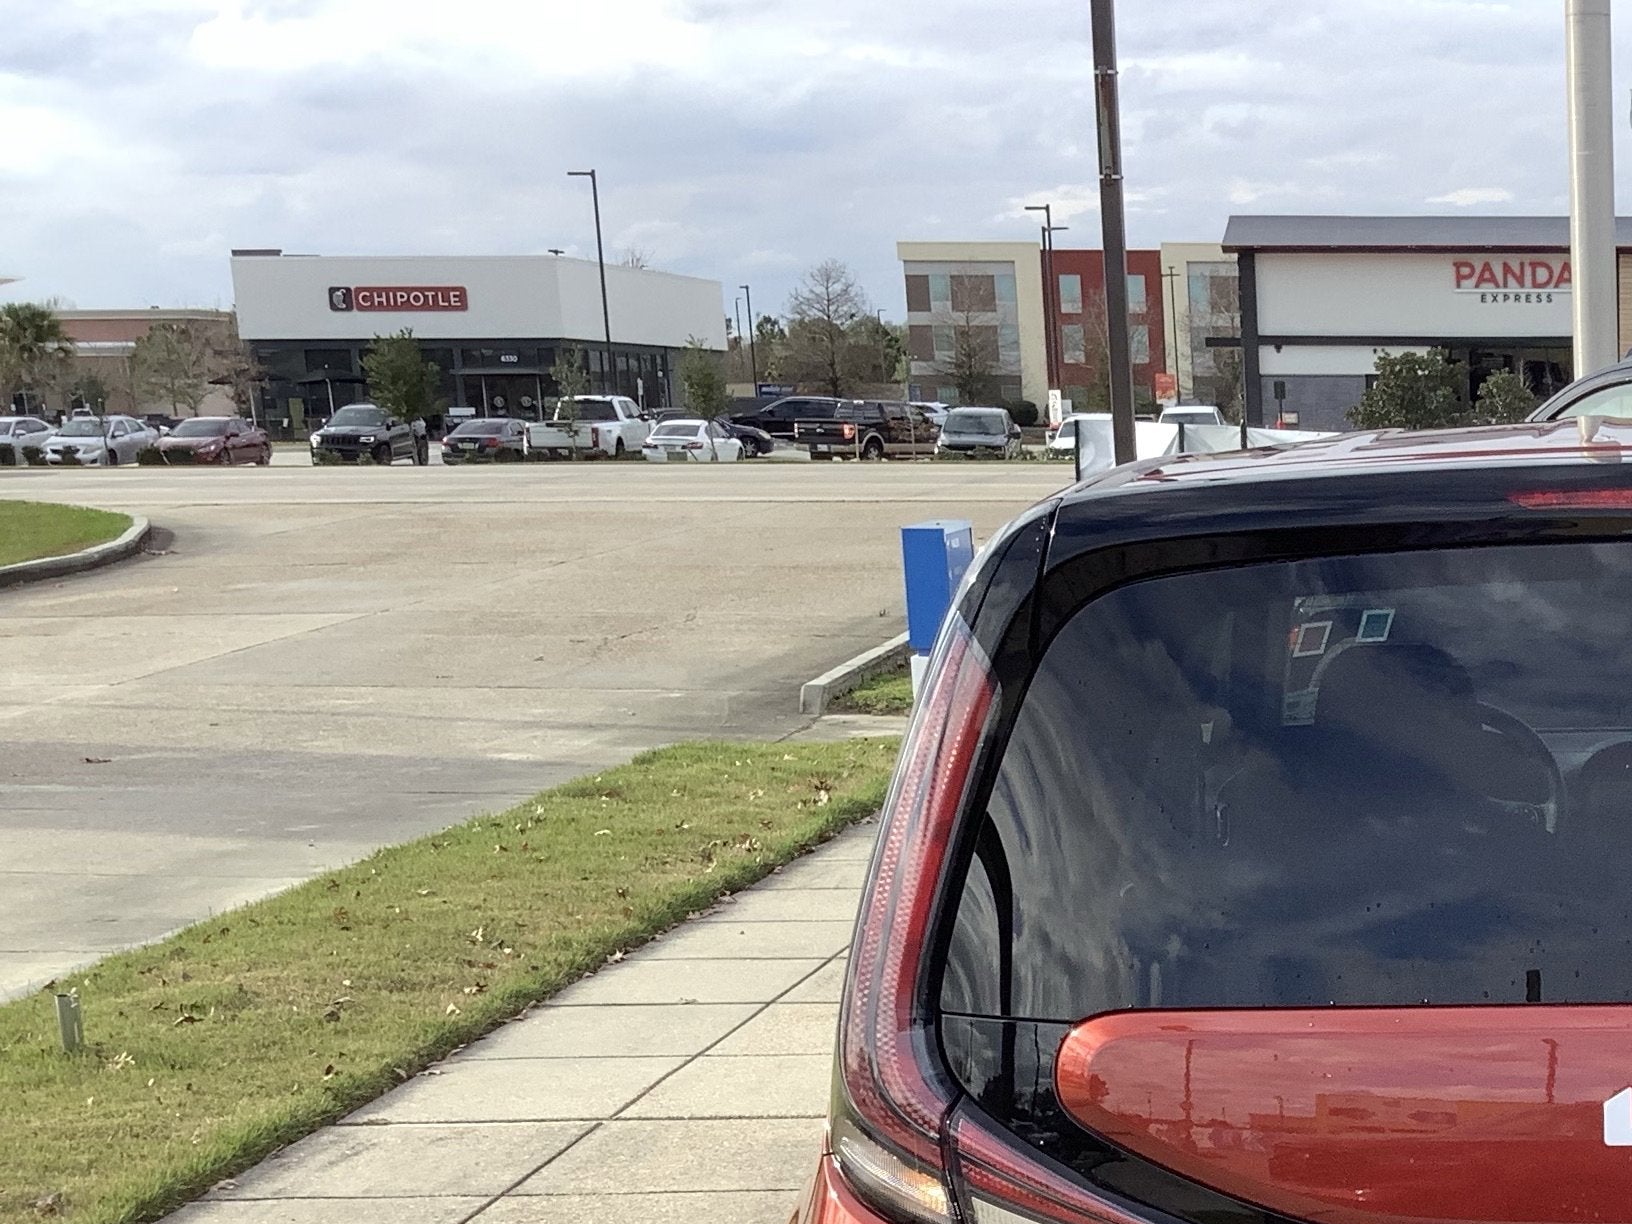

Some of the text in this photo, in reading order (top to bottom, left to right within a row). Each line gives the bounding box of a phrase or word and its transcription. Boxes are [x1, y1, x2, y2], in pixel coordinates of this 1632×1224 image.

[1453, 261, 1572, 289] PANDA
[358, 291, 462, 307] CHIPOTLE
[1481, 293, 1553, 303] EXPRESS
